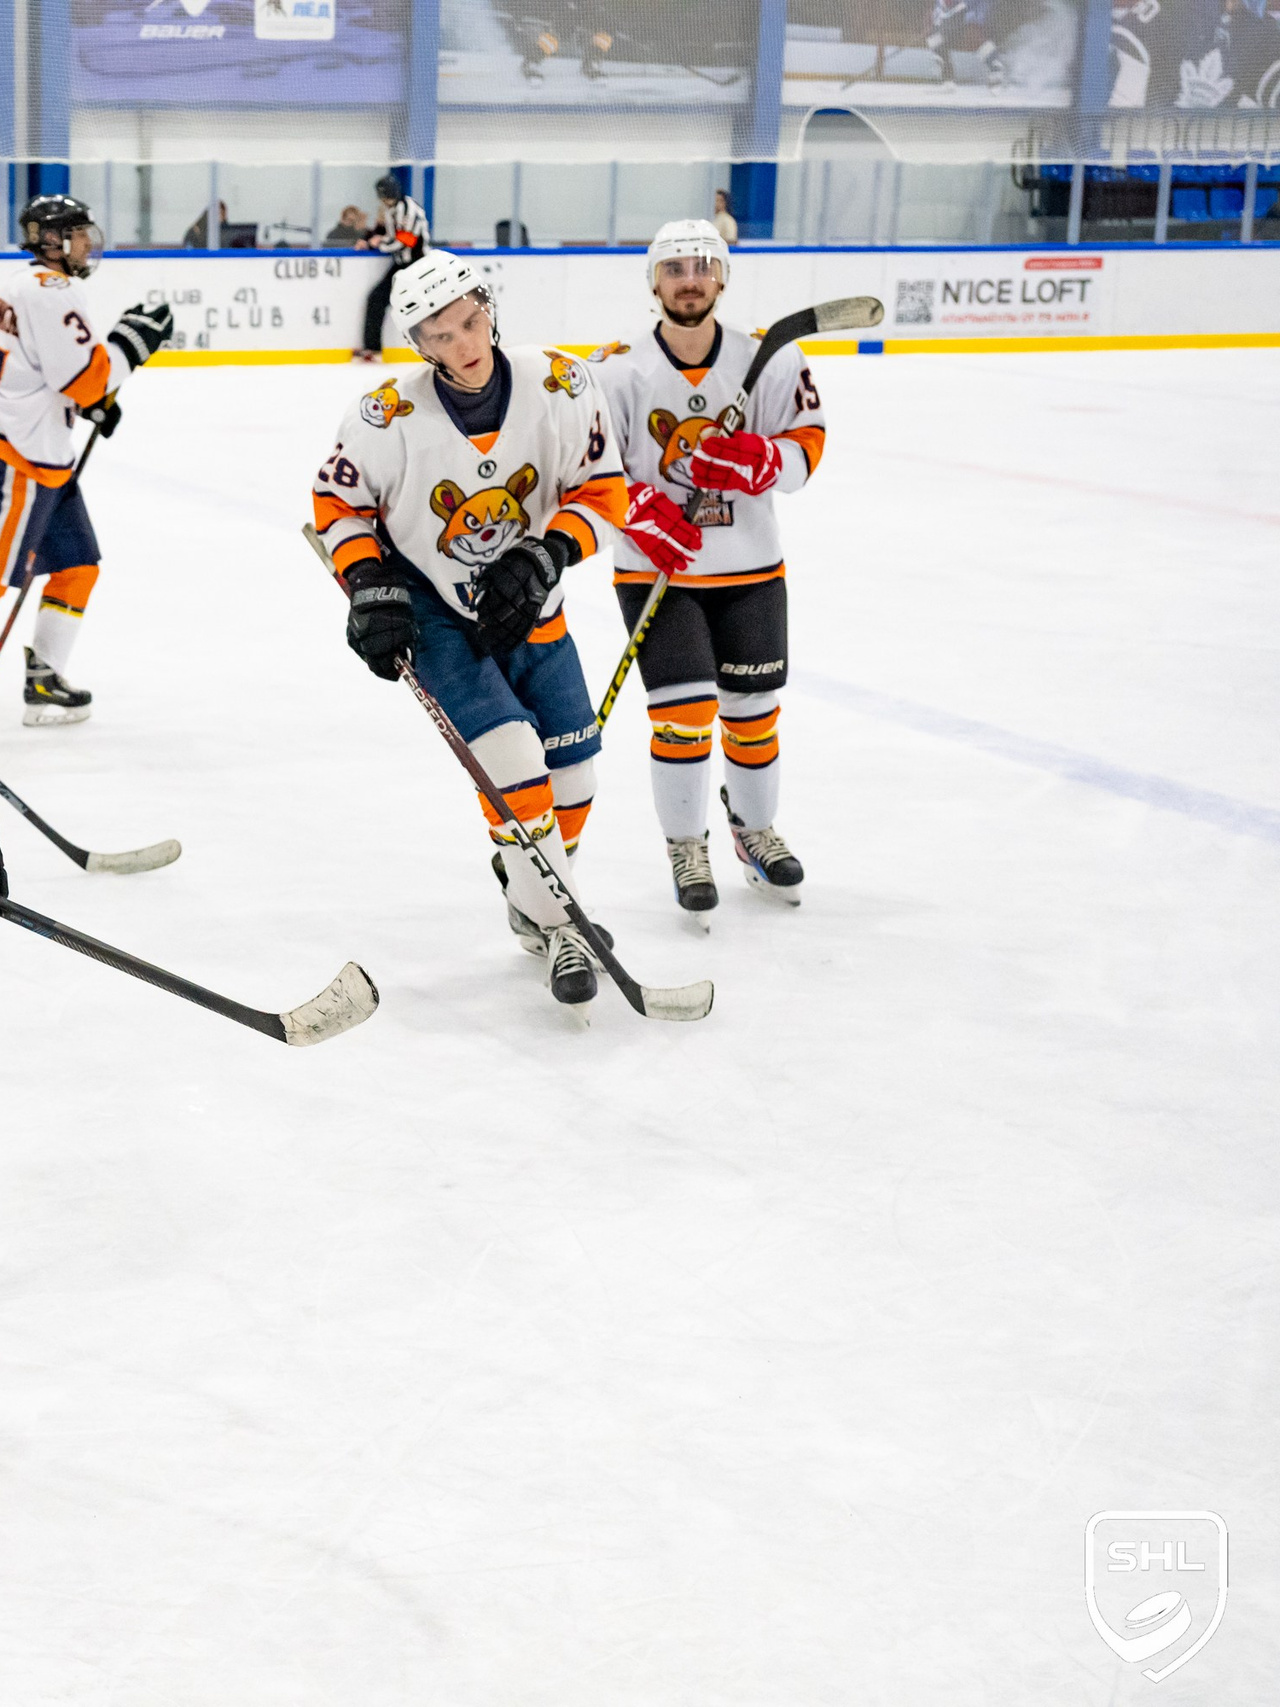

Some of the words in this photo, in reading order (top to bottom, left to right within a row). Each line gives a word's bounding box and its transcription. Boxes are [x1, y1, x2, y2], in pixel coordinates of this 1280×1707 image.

[274, 259, 318, 279] CLUB
[324, 259, 342, 278] 41
[147, 289, 202, 305] CLUB
[234, 288, 259, 304] 41
[1021, 278, 1092, 303] LOFT
[206, 306, 284, 329] CLUB
[312, 306, 331, 326] 41
[720, 659, 784, 676] BAUER
[544, 722, 601, 751] BAUER
[505, 819, 572, 905] CCM
